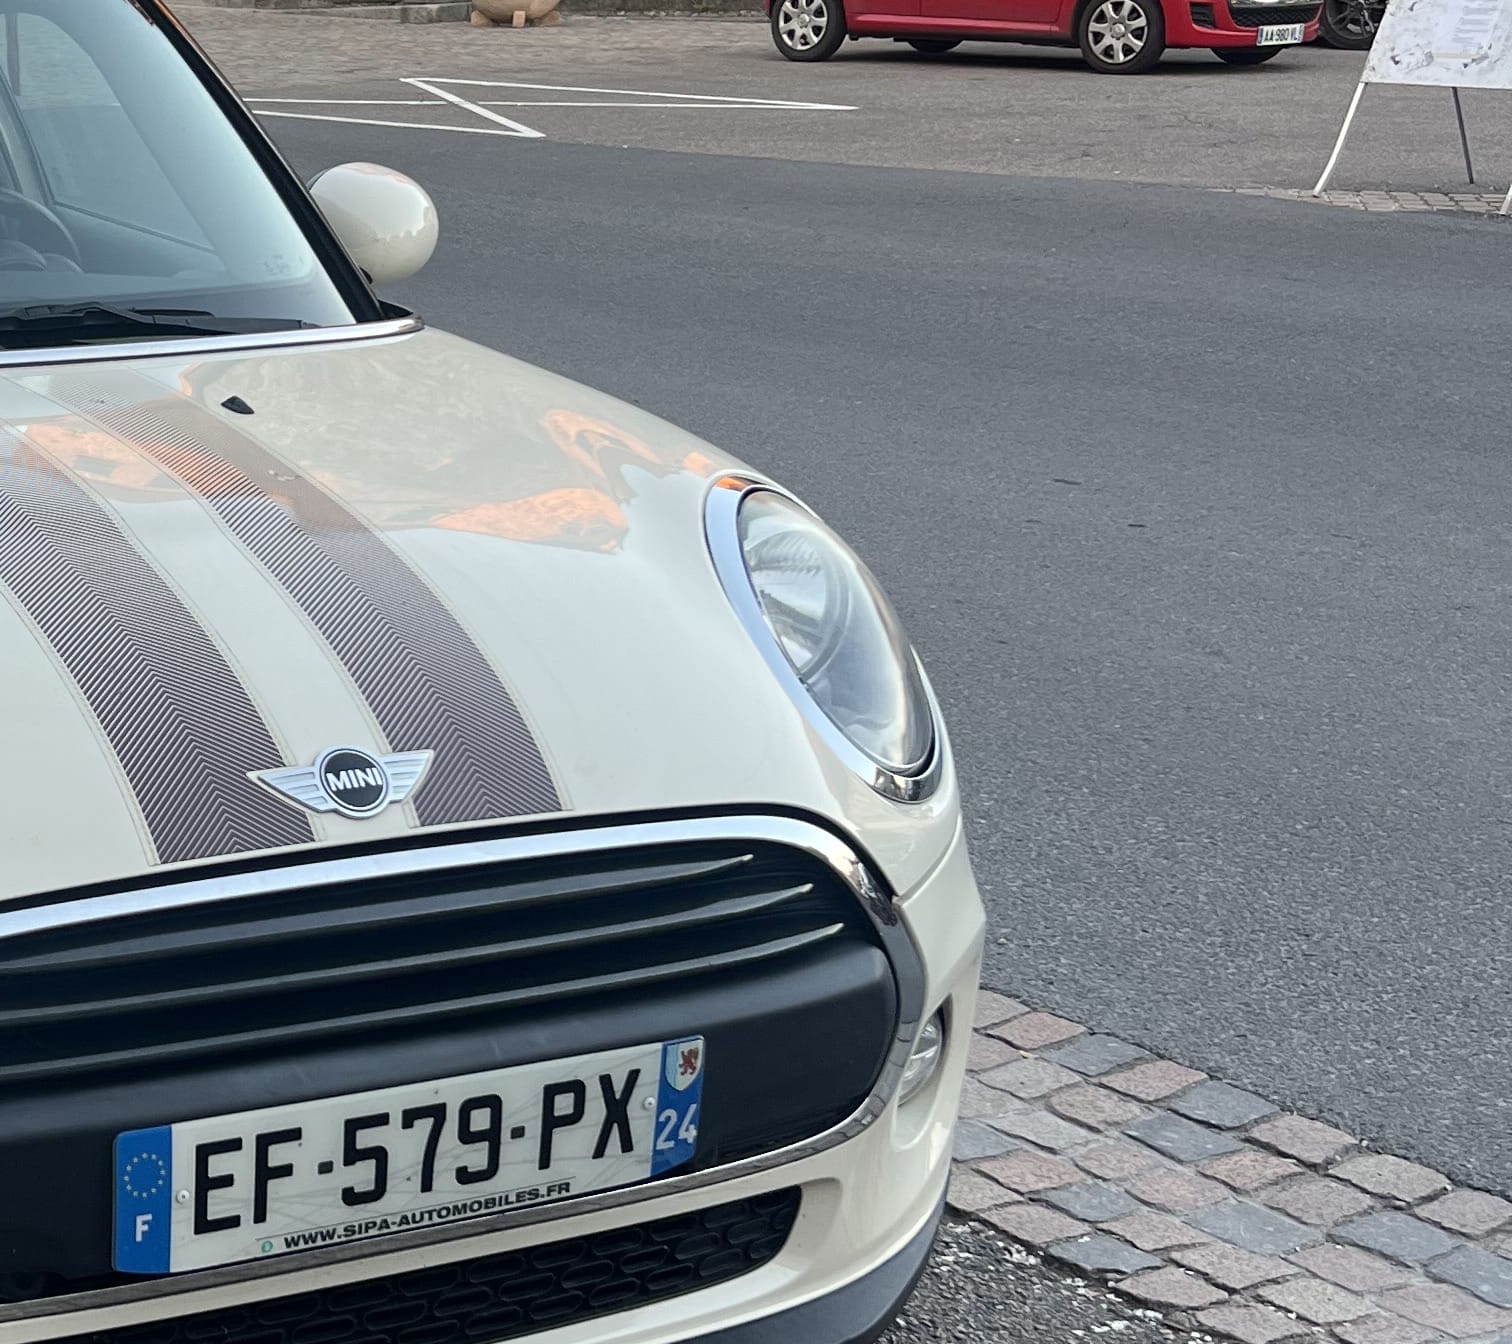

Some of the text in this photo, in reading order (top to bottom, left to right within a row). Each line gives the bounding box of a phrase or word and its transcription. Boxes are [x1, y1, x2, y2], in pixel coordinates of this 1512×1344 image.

[325, 767, 384, 792] MINI
[655, 1103, 697, 1150] 24
[193, 1067, 641, 1235] EF-579-PX
[135, 1213, 153, 1242] F
[283, 1181, 571, 1249] WWW.SIPA-AUTOMOBILES.FR
